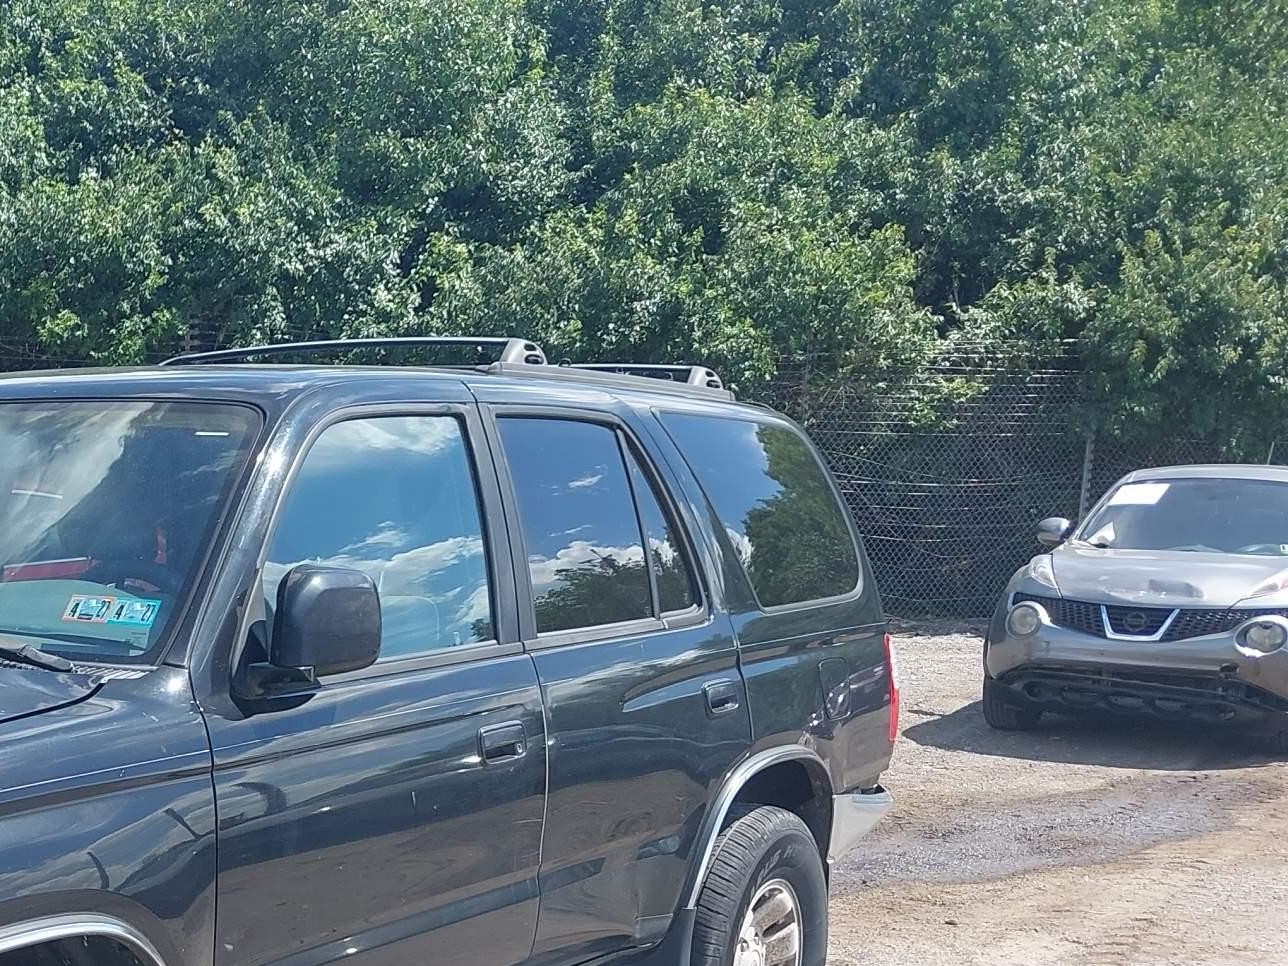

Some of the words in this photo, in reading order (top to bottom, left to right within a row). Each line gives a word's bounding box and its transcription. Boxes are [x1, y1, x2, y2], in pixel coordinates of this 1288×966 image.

[69, 602, 80, 617] 4
[96, 600, 111, 619] 27
[114, 604, 125, 620] 4
[140, 604, 156, 622] 27
